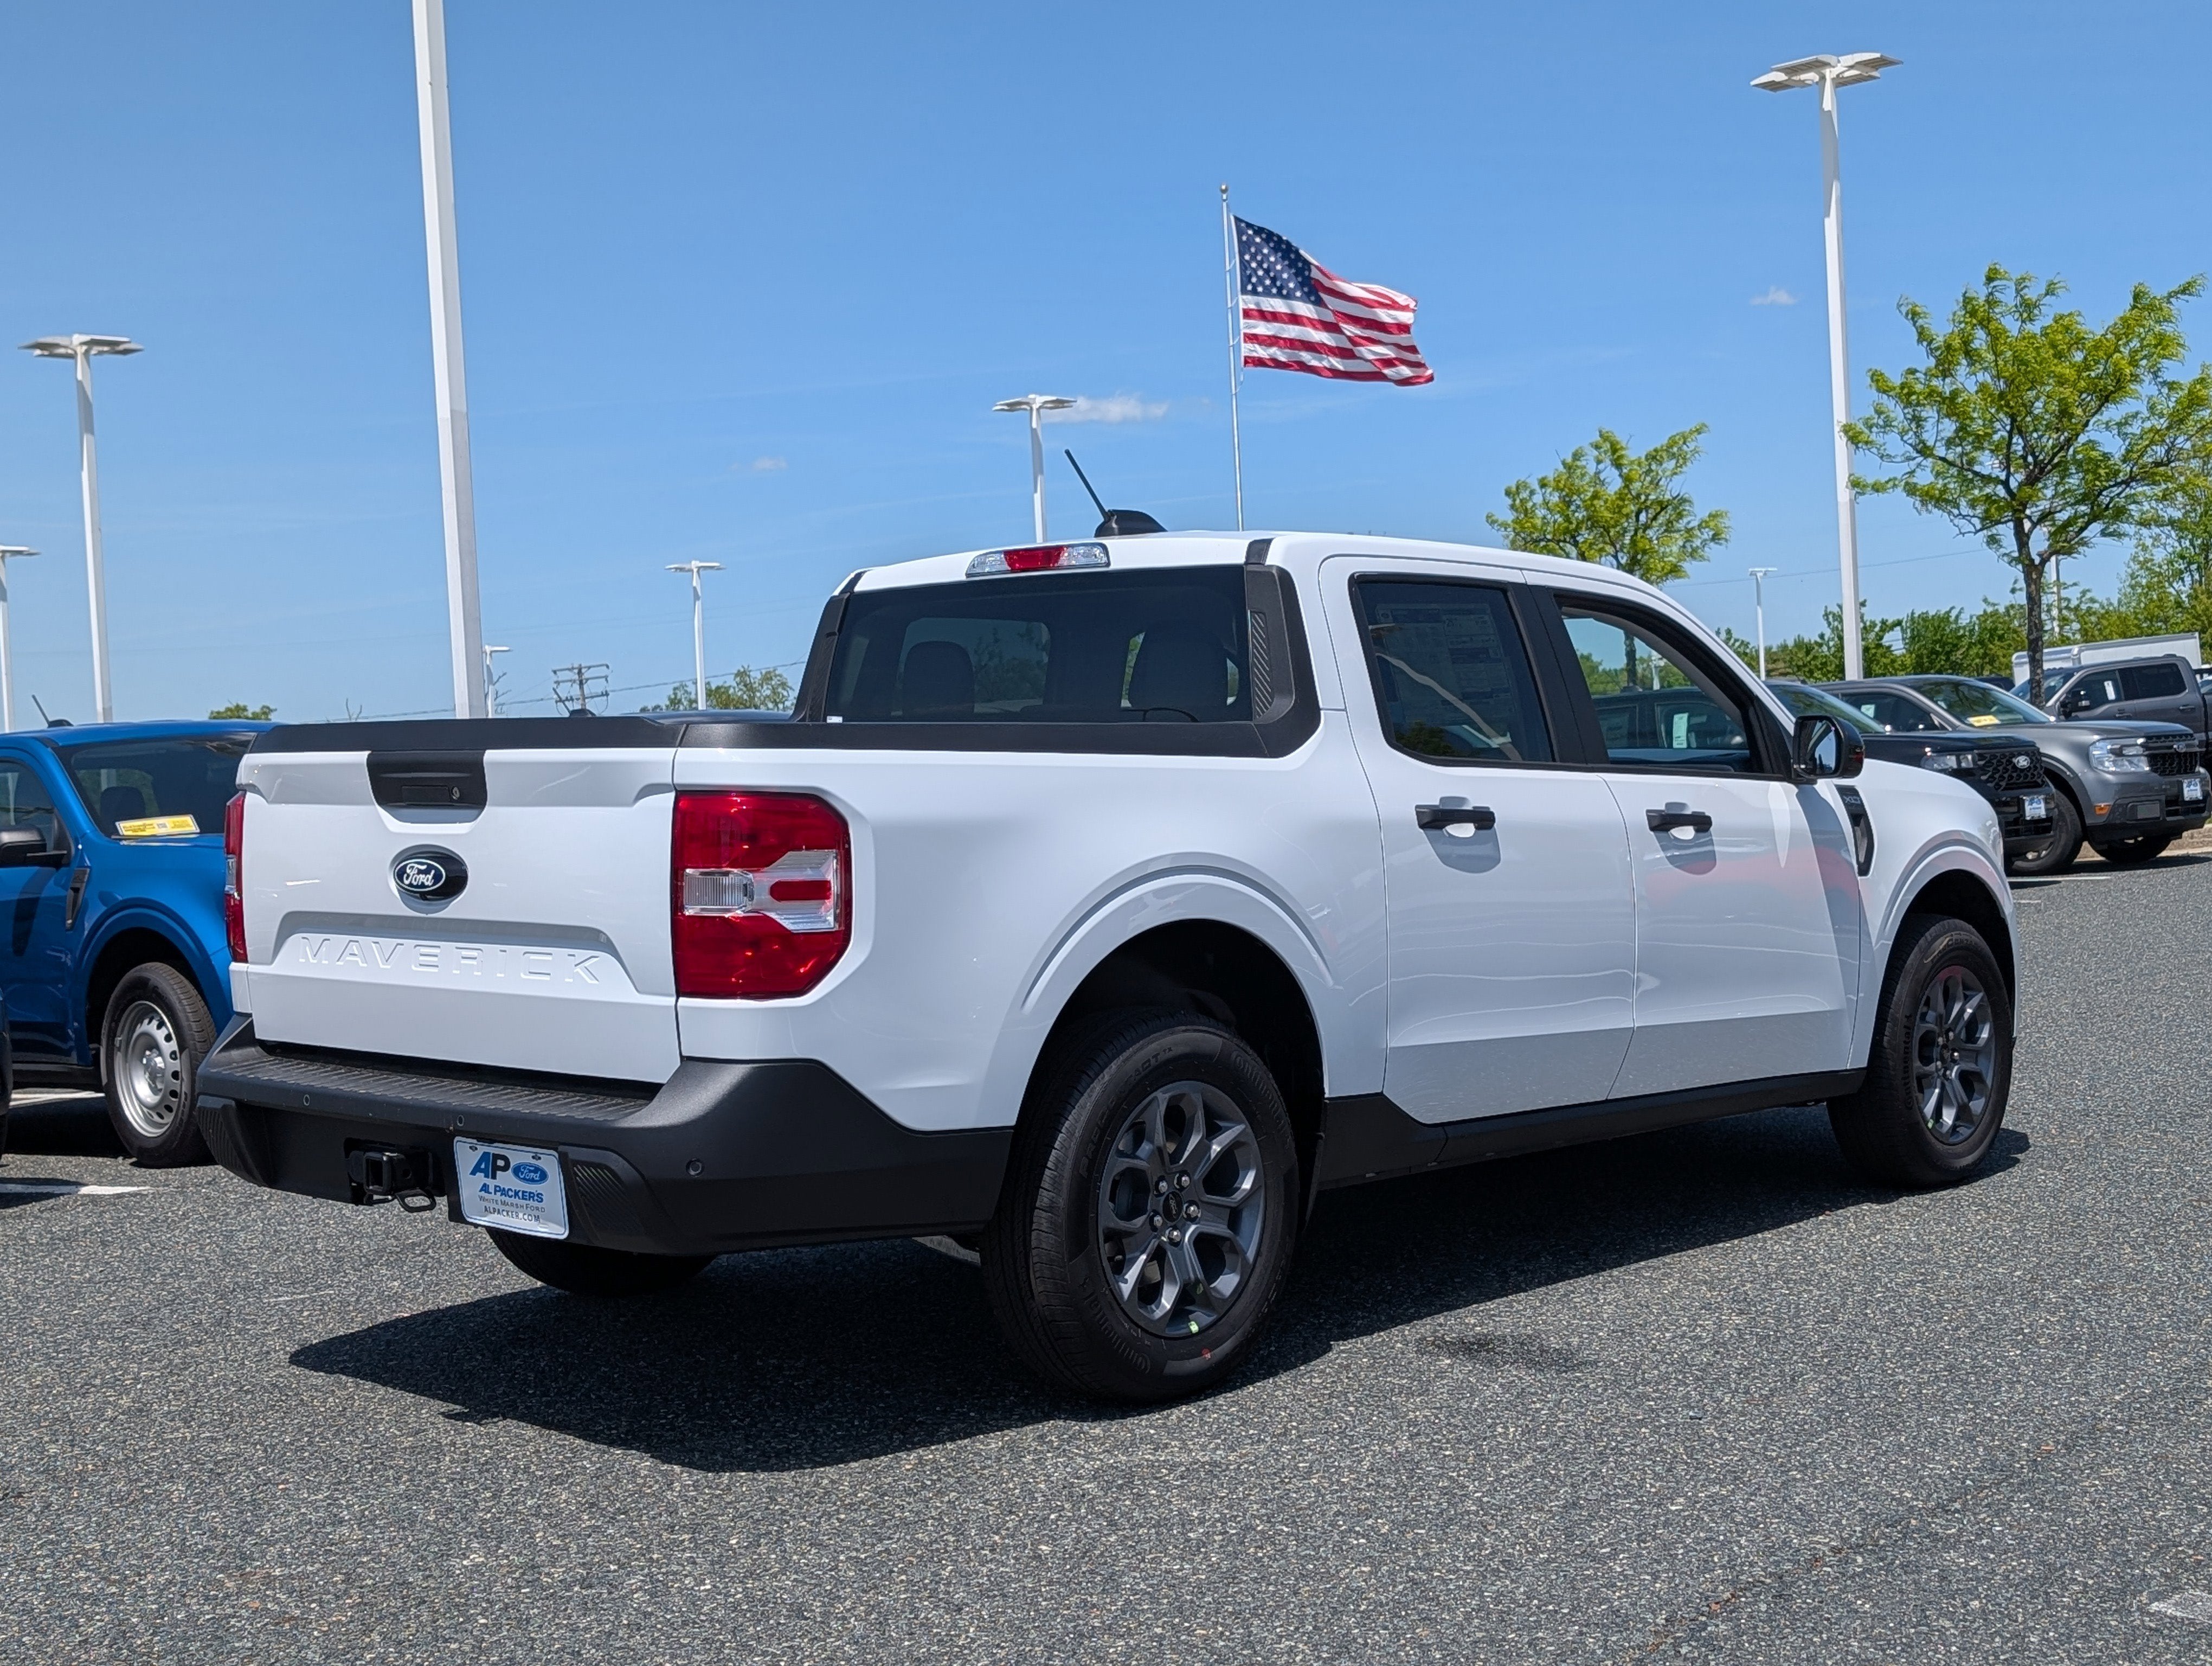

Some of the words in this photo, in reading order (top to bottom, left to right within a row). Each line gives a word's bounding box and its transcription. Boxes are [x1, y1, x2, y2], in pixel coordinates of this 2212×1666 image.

[403, 863, 435, 886] Ford
[299, 936, 600, 984] MAVERICK
[469, 1151, 511, 1181] AP
[519, 1164, 541, 1181] Ford
[479, 1182, 492, 1195] AL
[494, 1184, 544, 1203] PACKER'S
[484, 1205, 541, 1223] ALPACKER.COM
